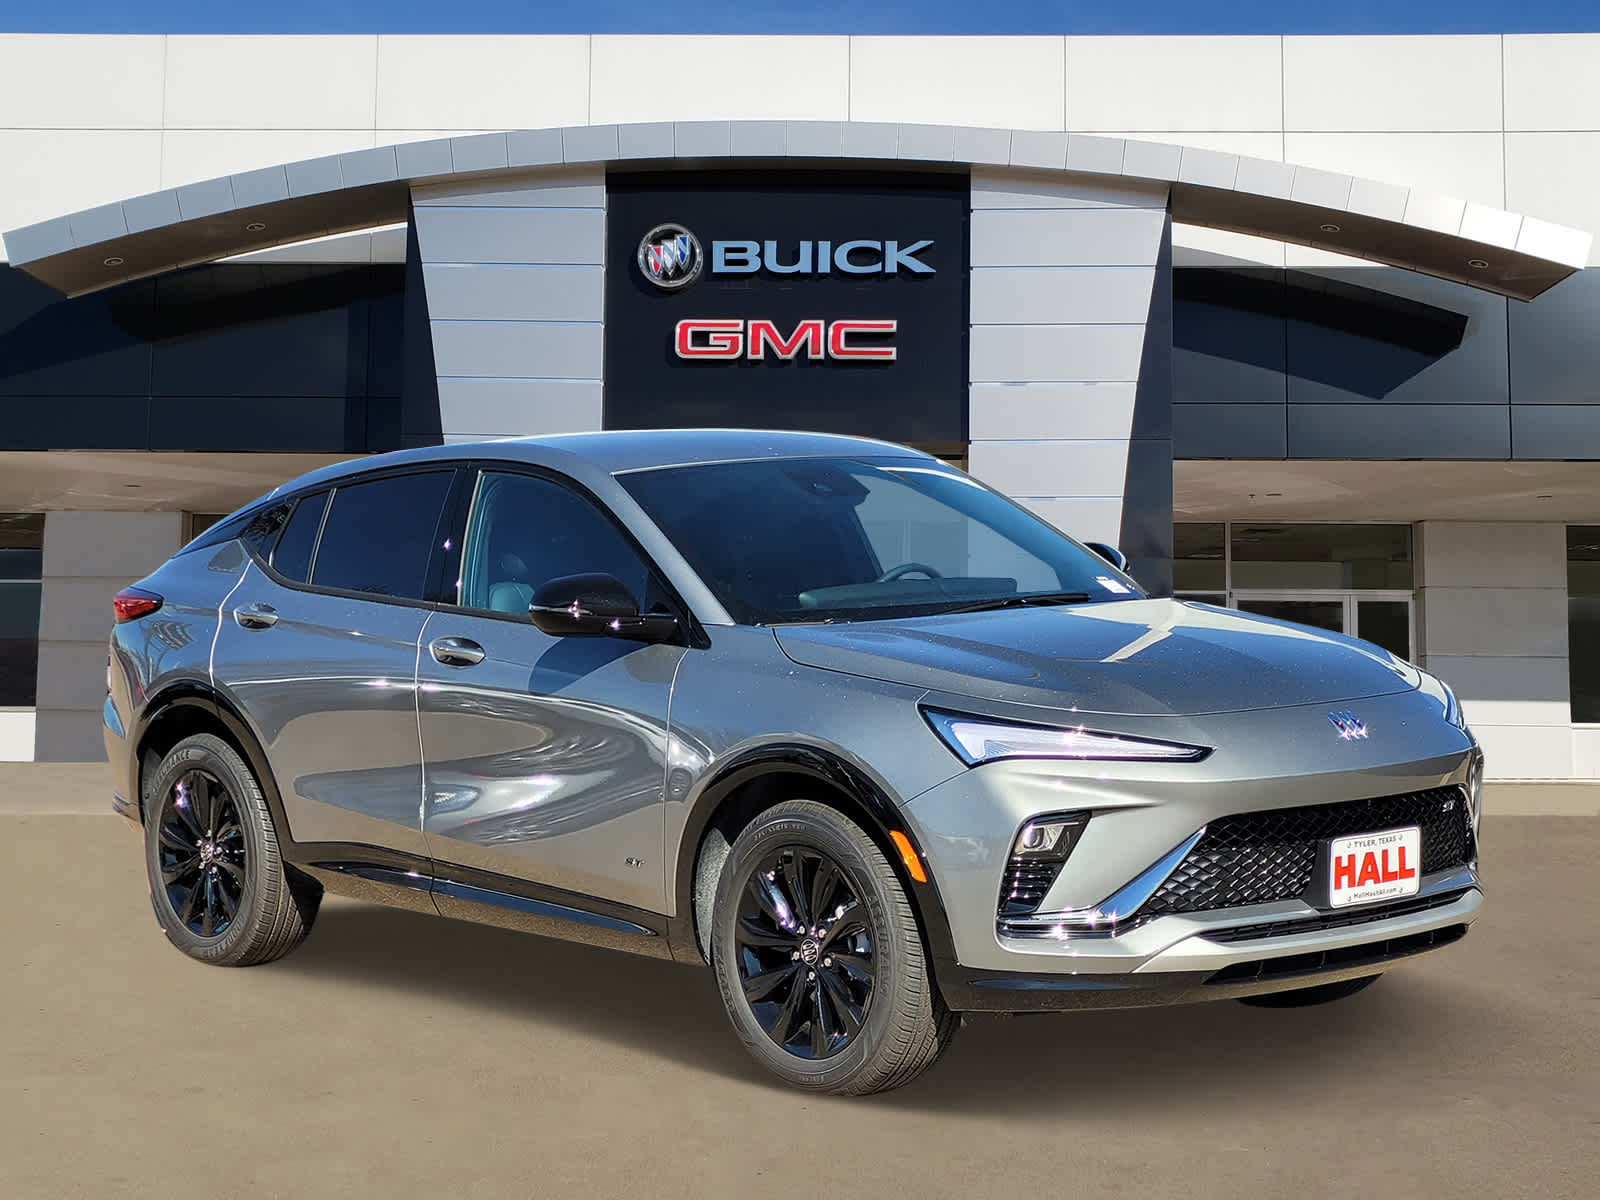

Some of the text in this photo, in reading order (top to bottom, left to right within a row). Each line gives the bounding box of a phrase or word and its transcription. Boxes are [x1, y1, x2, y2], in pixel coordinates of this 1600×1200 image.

[711, 240, 937, 274] BUICK
[674, 318, 898, 361] GMC
[1378, 835, 1397, 845] TEXAS
[1333, 845, 1416, 890] HALL
